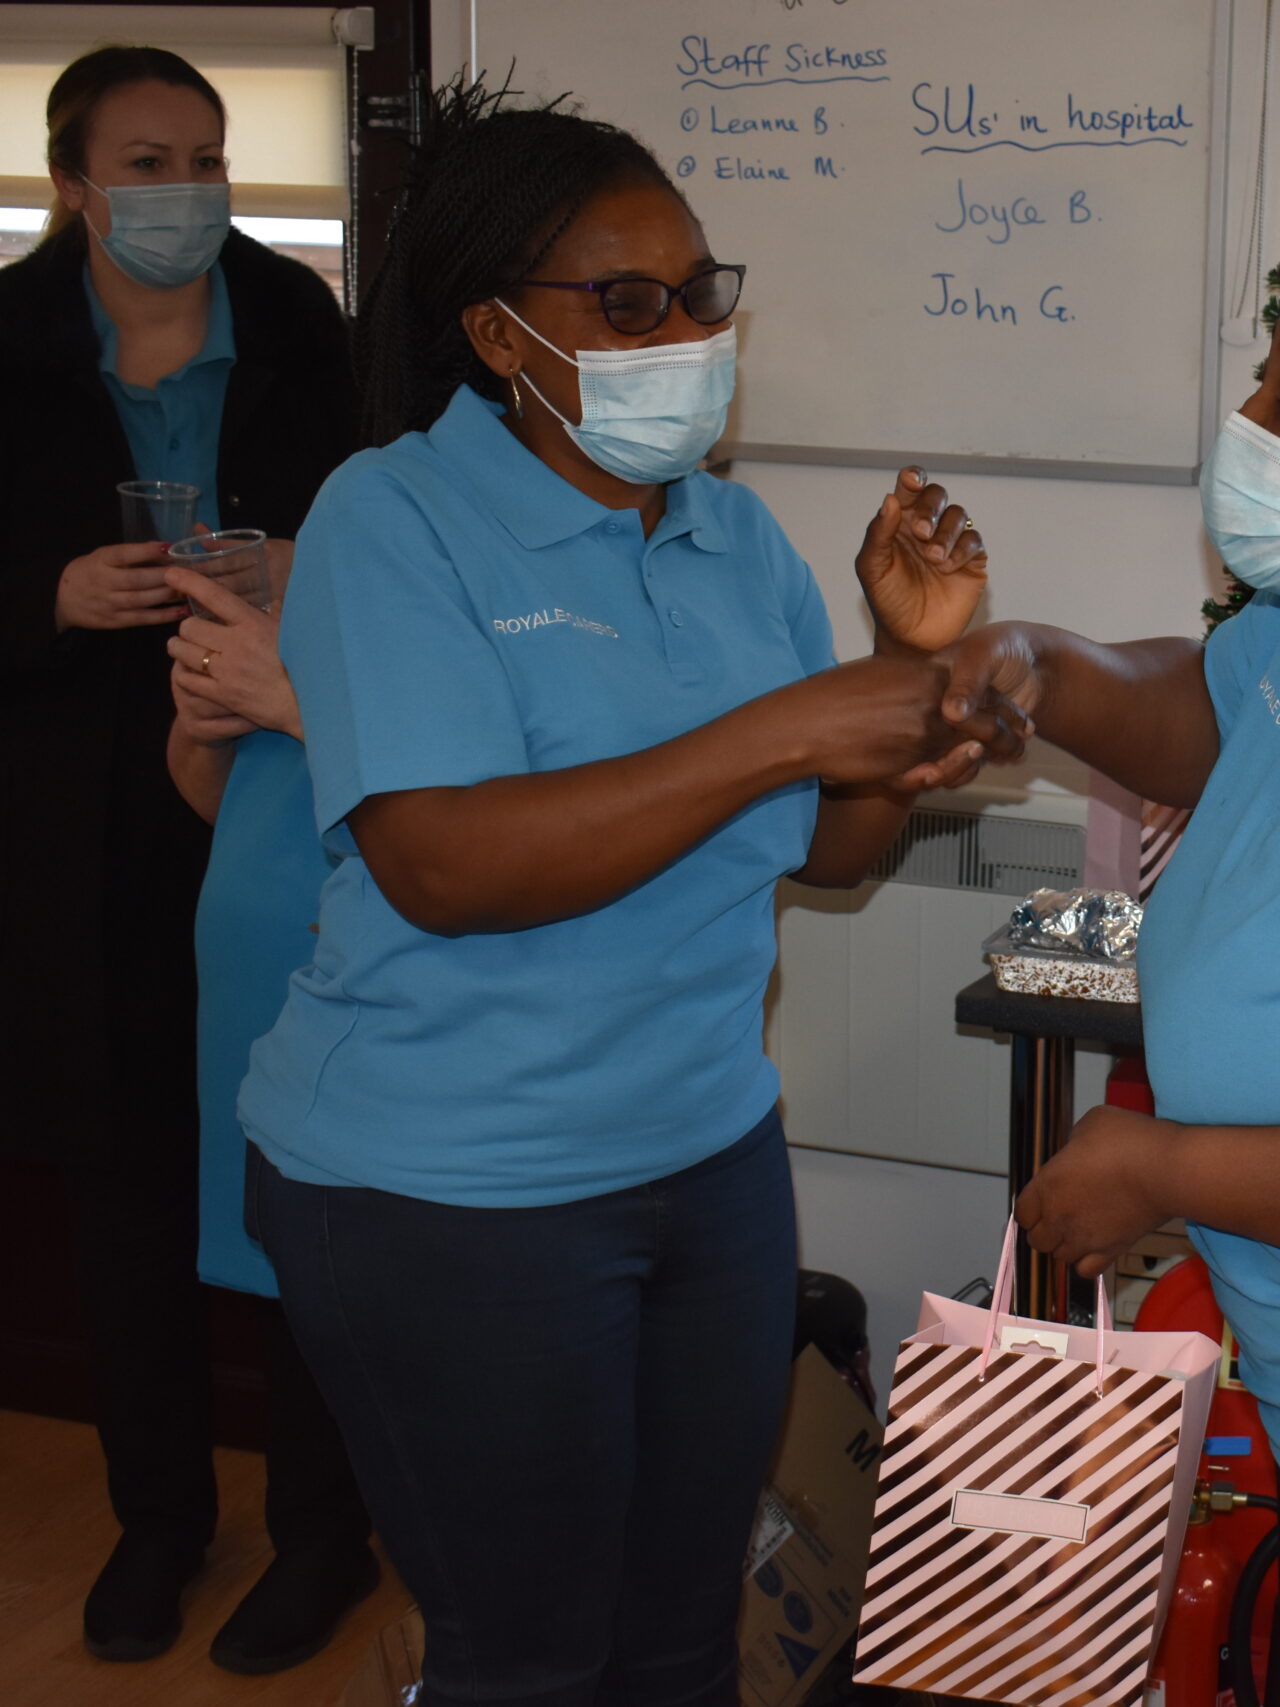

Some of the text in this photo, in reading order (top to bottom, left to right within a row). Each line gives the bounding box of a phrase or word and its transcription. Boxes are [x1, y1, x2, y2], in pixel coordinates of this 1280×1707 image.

[677, 35, 888, 77] Staff Sickness
[711, 105, 800, 134] Leanne
[1014, 99, 1048, 133] in
[1067, 93, 1193, 139] hospital
[714, 156, 790, 180] Elaine
[935, 178, 1047, 244] Joyce
[924, 273, 1017, 326] John
[493, 608, 567, 635] ROYALE
